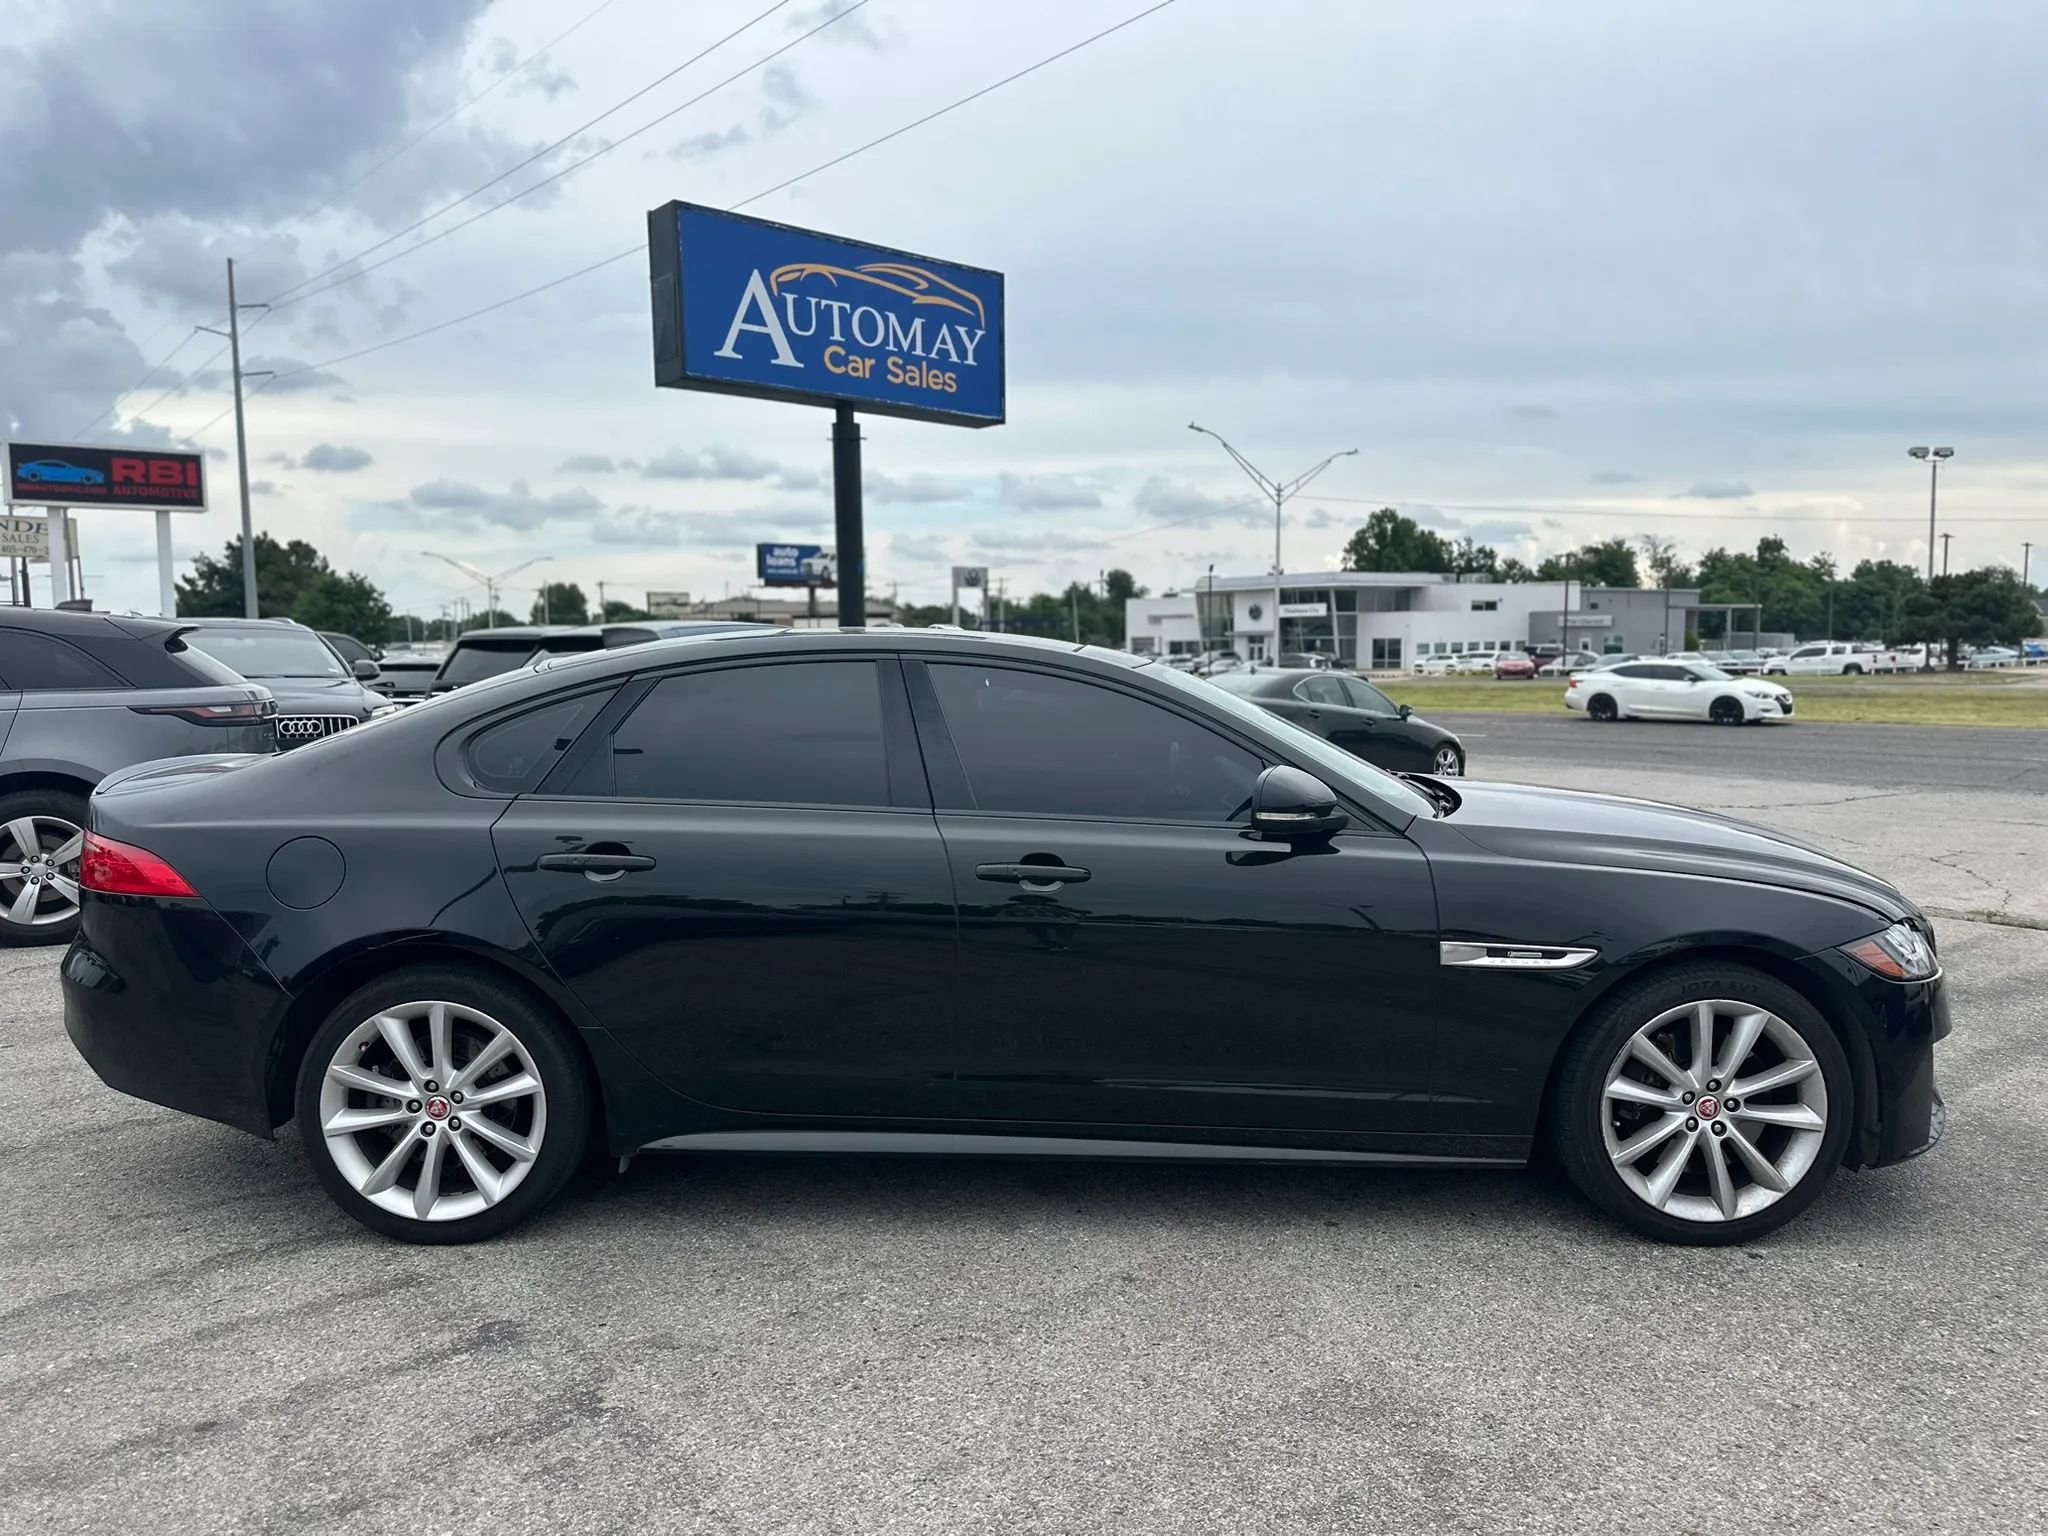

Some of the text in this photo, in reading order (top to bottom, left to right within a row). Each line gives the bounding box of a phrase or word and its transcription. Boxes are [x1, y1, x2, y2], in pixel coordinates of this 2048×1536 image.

[713, 268, 986, 369] AUTOMAY
[824, 346, 958, 394] Car Sales
[111, 457, 198, 487] RBI
[113, 486, 198, 498] AUTOMOTIVE
[2, 533, 40, 544] SALES
[772, 546, 800, 557] auto
[766, 554, 797, 566] loans
